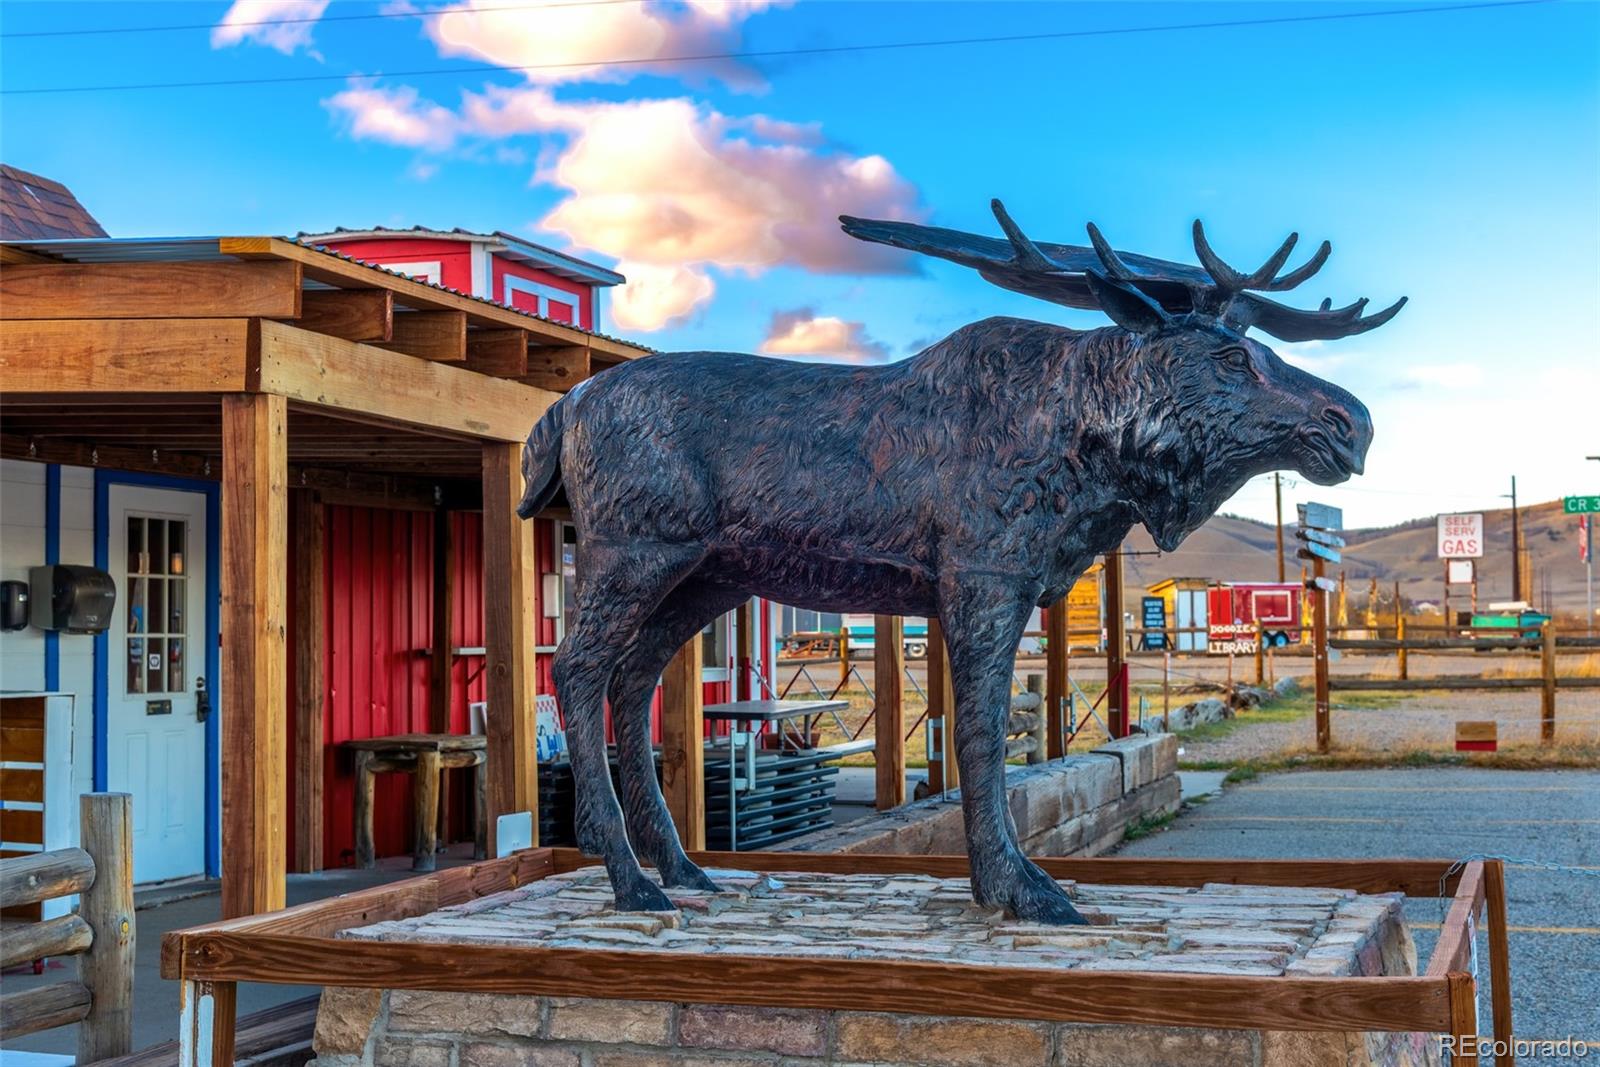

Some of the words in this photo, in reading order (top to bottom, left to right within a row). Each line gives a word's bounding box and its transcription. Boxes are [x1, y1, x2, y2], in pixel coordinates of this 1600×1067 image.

[1568, 498, 1587, 511] CR
[1445, 516, 1474, 526] SELF
[1445, 527, 1475, 536] SERV
[1443, 539, 1477, 554] GAS
[1210, 624, 1251, 634] DOGGIE
[1208, 642, 1258, 654] LIBRARY
